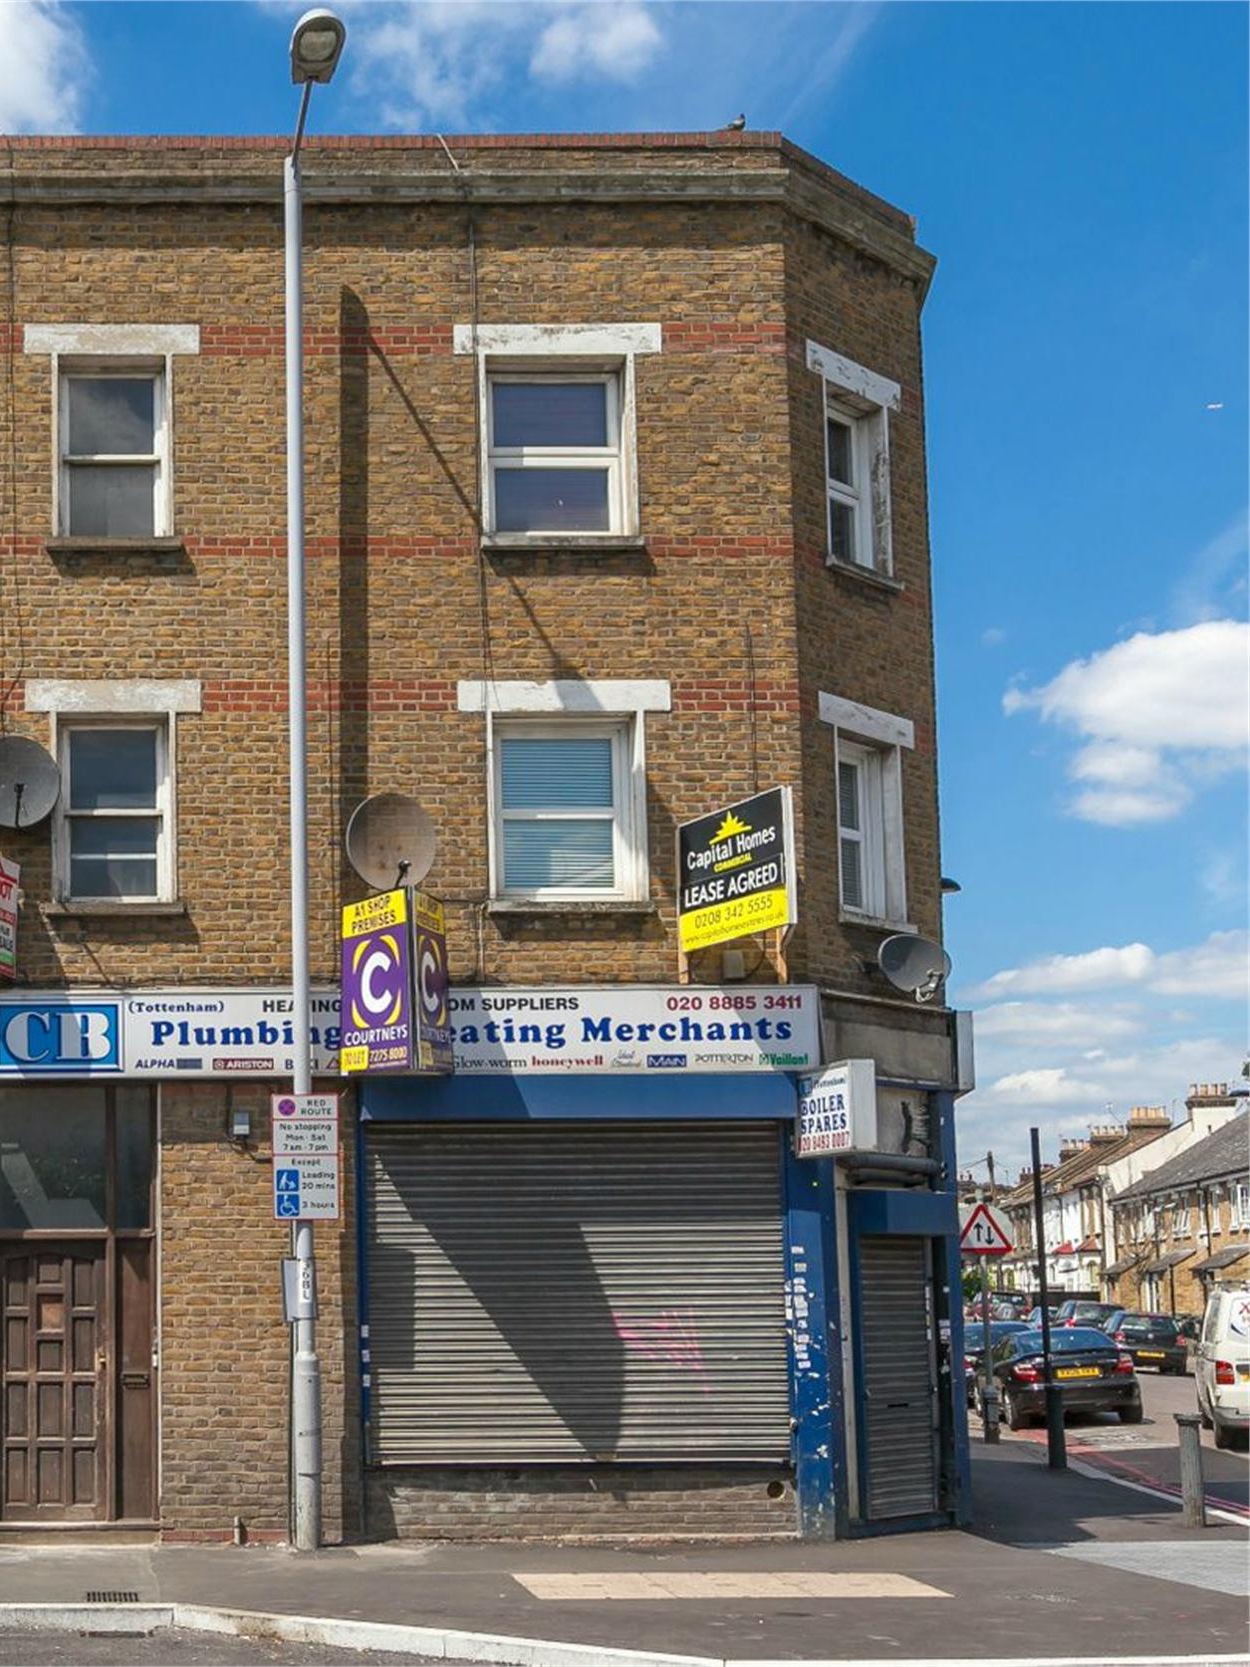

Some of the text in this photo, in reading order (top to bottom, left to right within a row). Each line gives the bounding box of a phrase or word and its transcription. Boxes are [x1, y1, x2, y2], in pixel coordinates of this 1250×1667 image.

[686, 826, 776, 871] Capital Homes
[684, 862, 778, 909] LEASE AGREED
[368, 895, 392, 912] SHOP
[694, 909, 722, 929] 0208
[724, 902, 744, 921] 342
[747, 894, 774, 915] 5555
[350, 909, 397, 934] PREMISES
[128, 999, 226, 1014] (Tottenham)
[262, 999, 342, 1013] HEING
[482, 997, 579, 1010] SUPPLIERS
[666, 995, 802, 1010] 020 8885 3411
[5, 1010, 112, 1062] CB
[344, 1023, 408, 1046] COURTNEYS
[581, 1017, 791, 1044] Merchants
[135, 1058, 175, 1069] ALPHA
[532, 1055, 603, 1069] honeywell
[301, 1107, 332, 1115] ROUTE
[307, 1099, 327, 1107] RED
[800, 1094, 845, 1116] BOILER
[294, 1123, 332, 1132] stopping
[800, 1112, 847, 1135] SPARES
[291, 1158, 321, 1167] Except
[302, 1171, 335, 1180] Loading
[310, 1201, 335, 1209] hours
